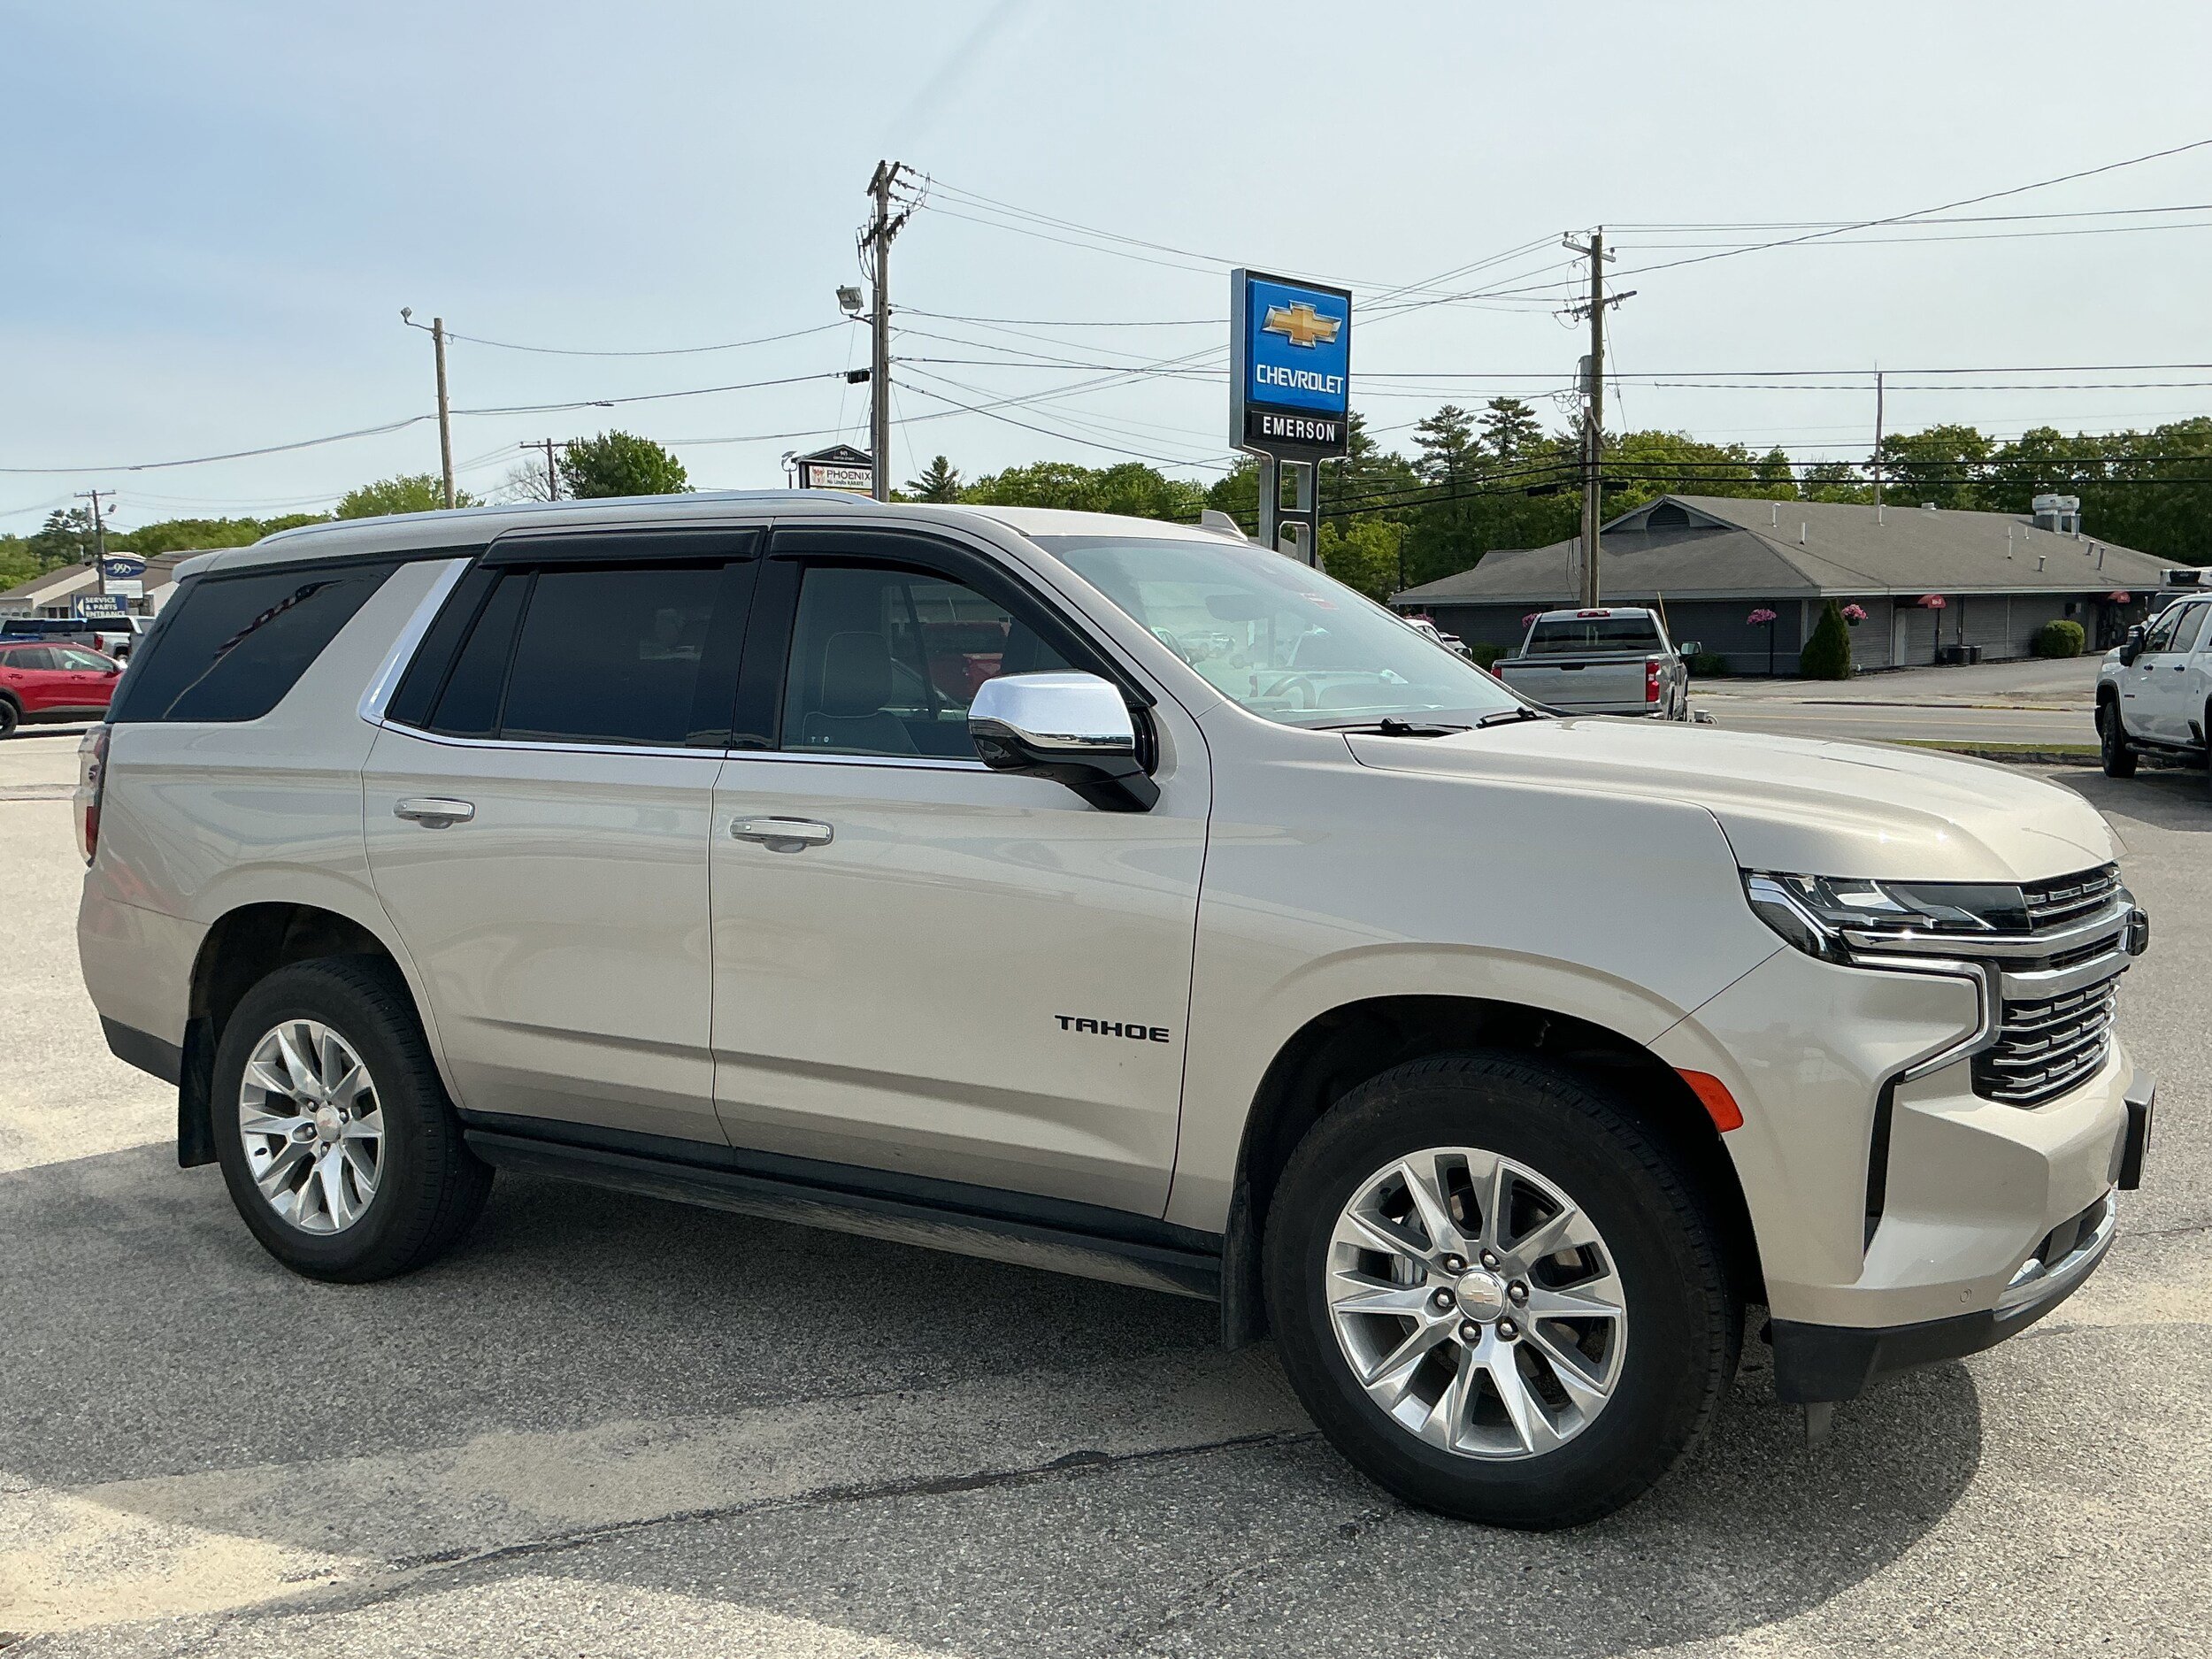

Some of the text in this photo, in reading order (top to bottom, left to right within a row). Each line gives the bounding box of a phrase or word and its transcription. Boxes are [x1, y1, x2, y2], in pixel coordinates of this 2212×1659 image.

[1256, 364, 1344, 395] CHEVROLET
[1263, 415, 1335, 442] EMERSON
[826, 470, 871, 480] PHOENIX
[1054, 1014, 1170, 1043] TAHOE
